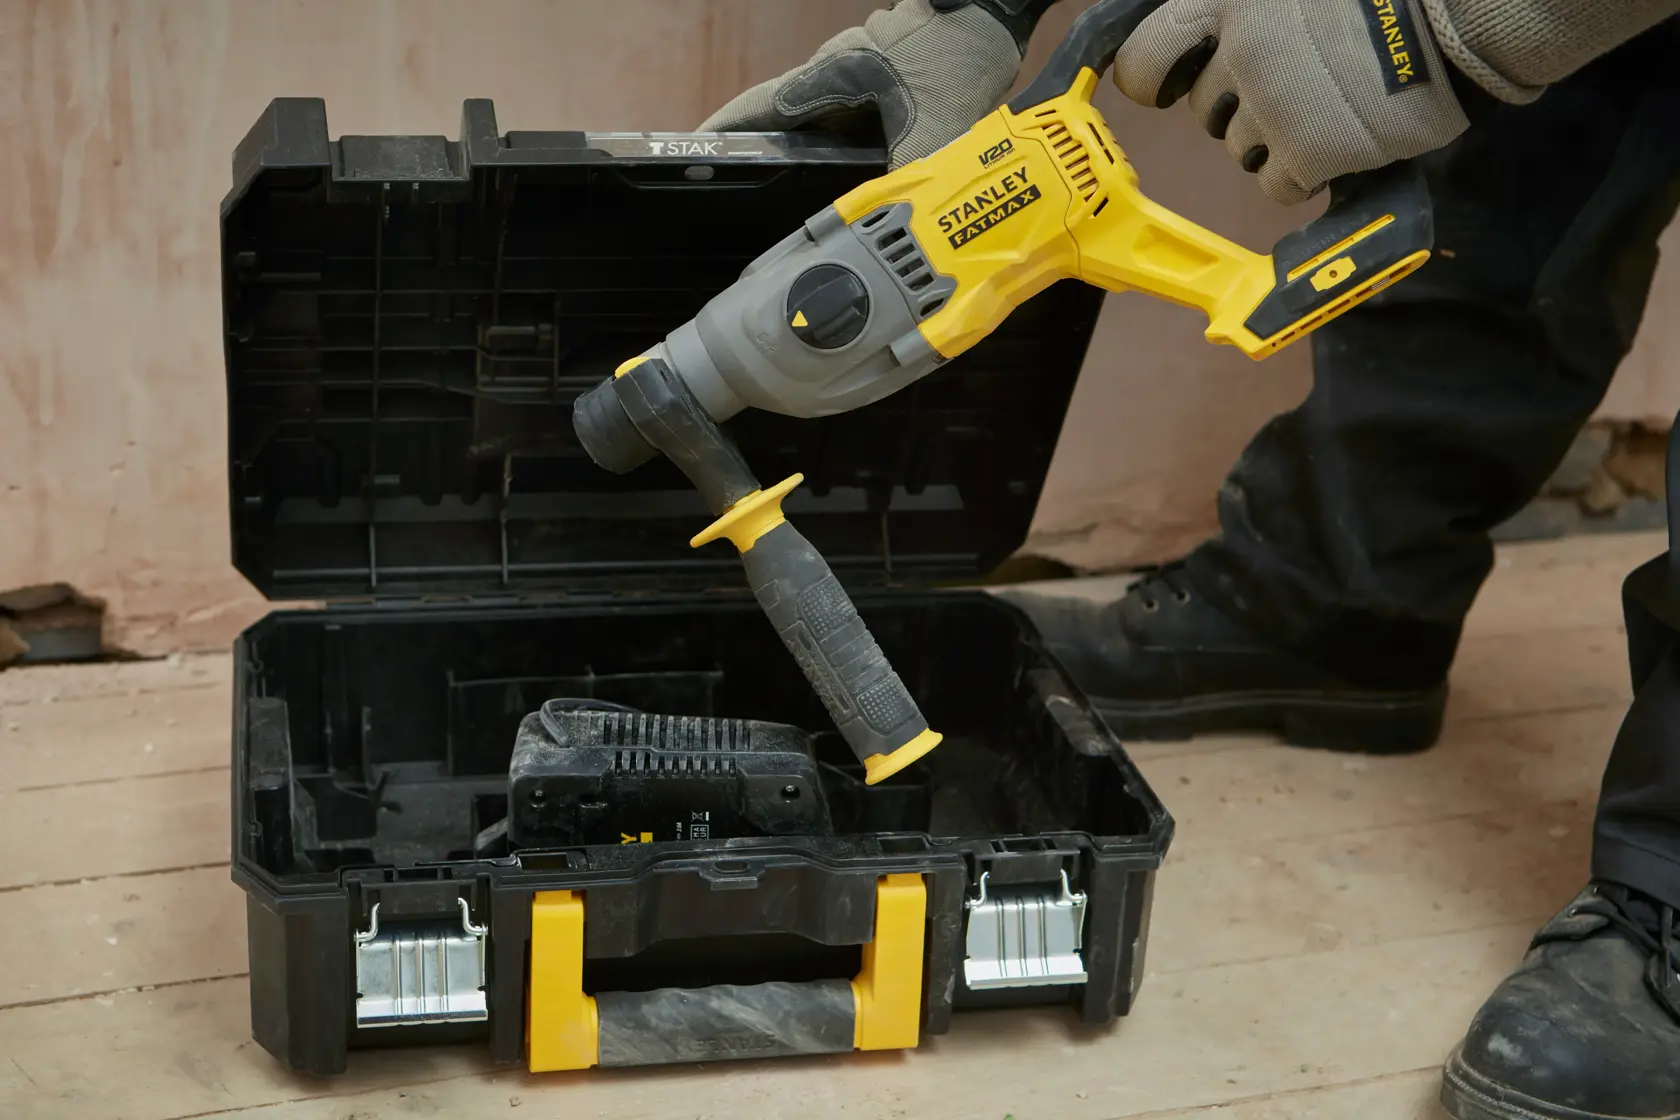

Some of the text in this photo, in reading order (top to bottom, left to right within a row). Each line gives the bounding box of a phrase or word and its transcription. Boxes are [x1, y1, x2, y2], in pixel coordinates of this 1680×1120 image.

[978, 138, 1013, 166] V20
[937, 166, 1028, 233] STANLEY
[953, 189, 1035, 245] FATMAX
